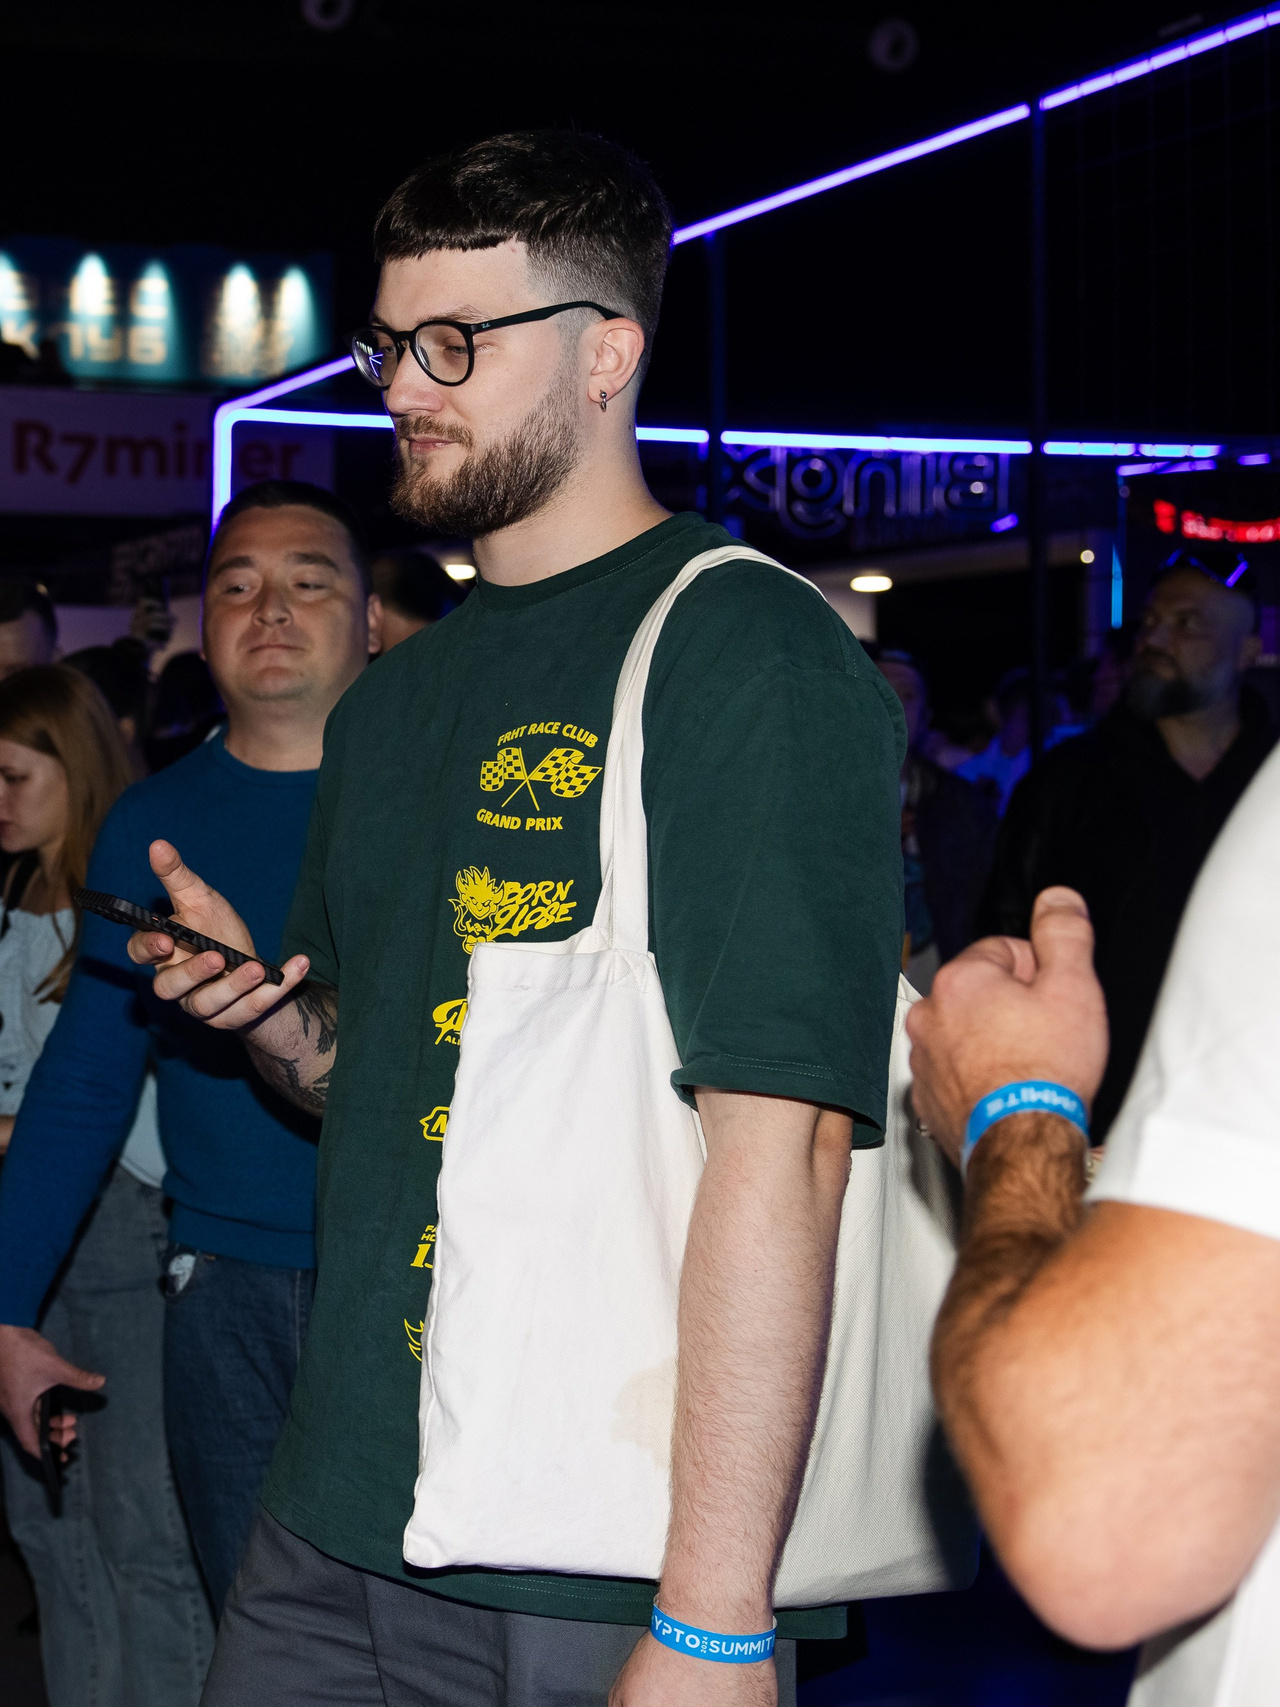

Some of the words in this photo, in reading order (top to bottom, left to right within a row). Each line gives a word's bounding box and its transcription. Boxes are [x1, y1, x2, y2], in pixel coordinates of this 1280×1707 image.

[497, 725, 527, 746] FRHT
[527, 721, 561, 736] RACE
[561, 723, 599, 748] CLUB
[476, 808, 521, 830] GRAND
[525, 816, 564, 831] PRIX
[502, 879, 574, 905] BORN
[651, 1614, 701, 1649] YPTO
[700, 1636, 709, 1654] 2024
[708, 1636, 773, 1656] SUMMIT
